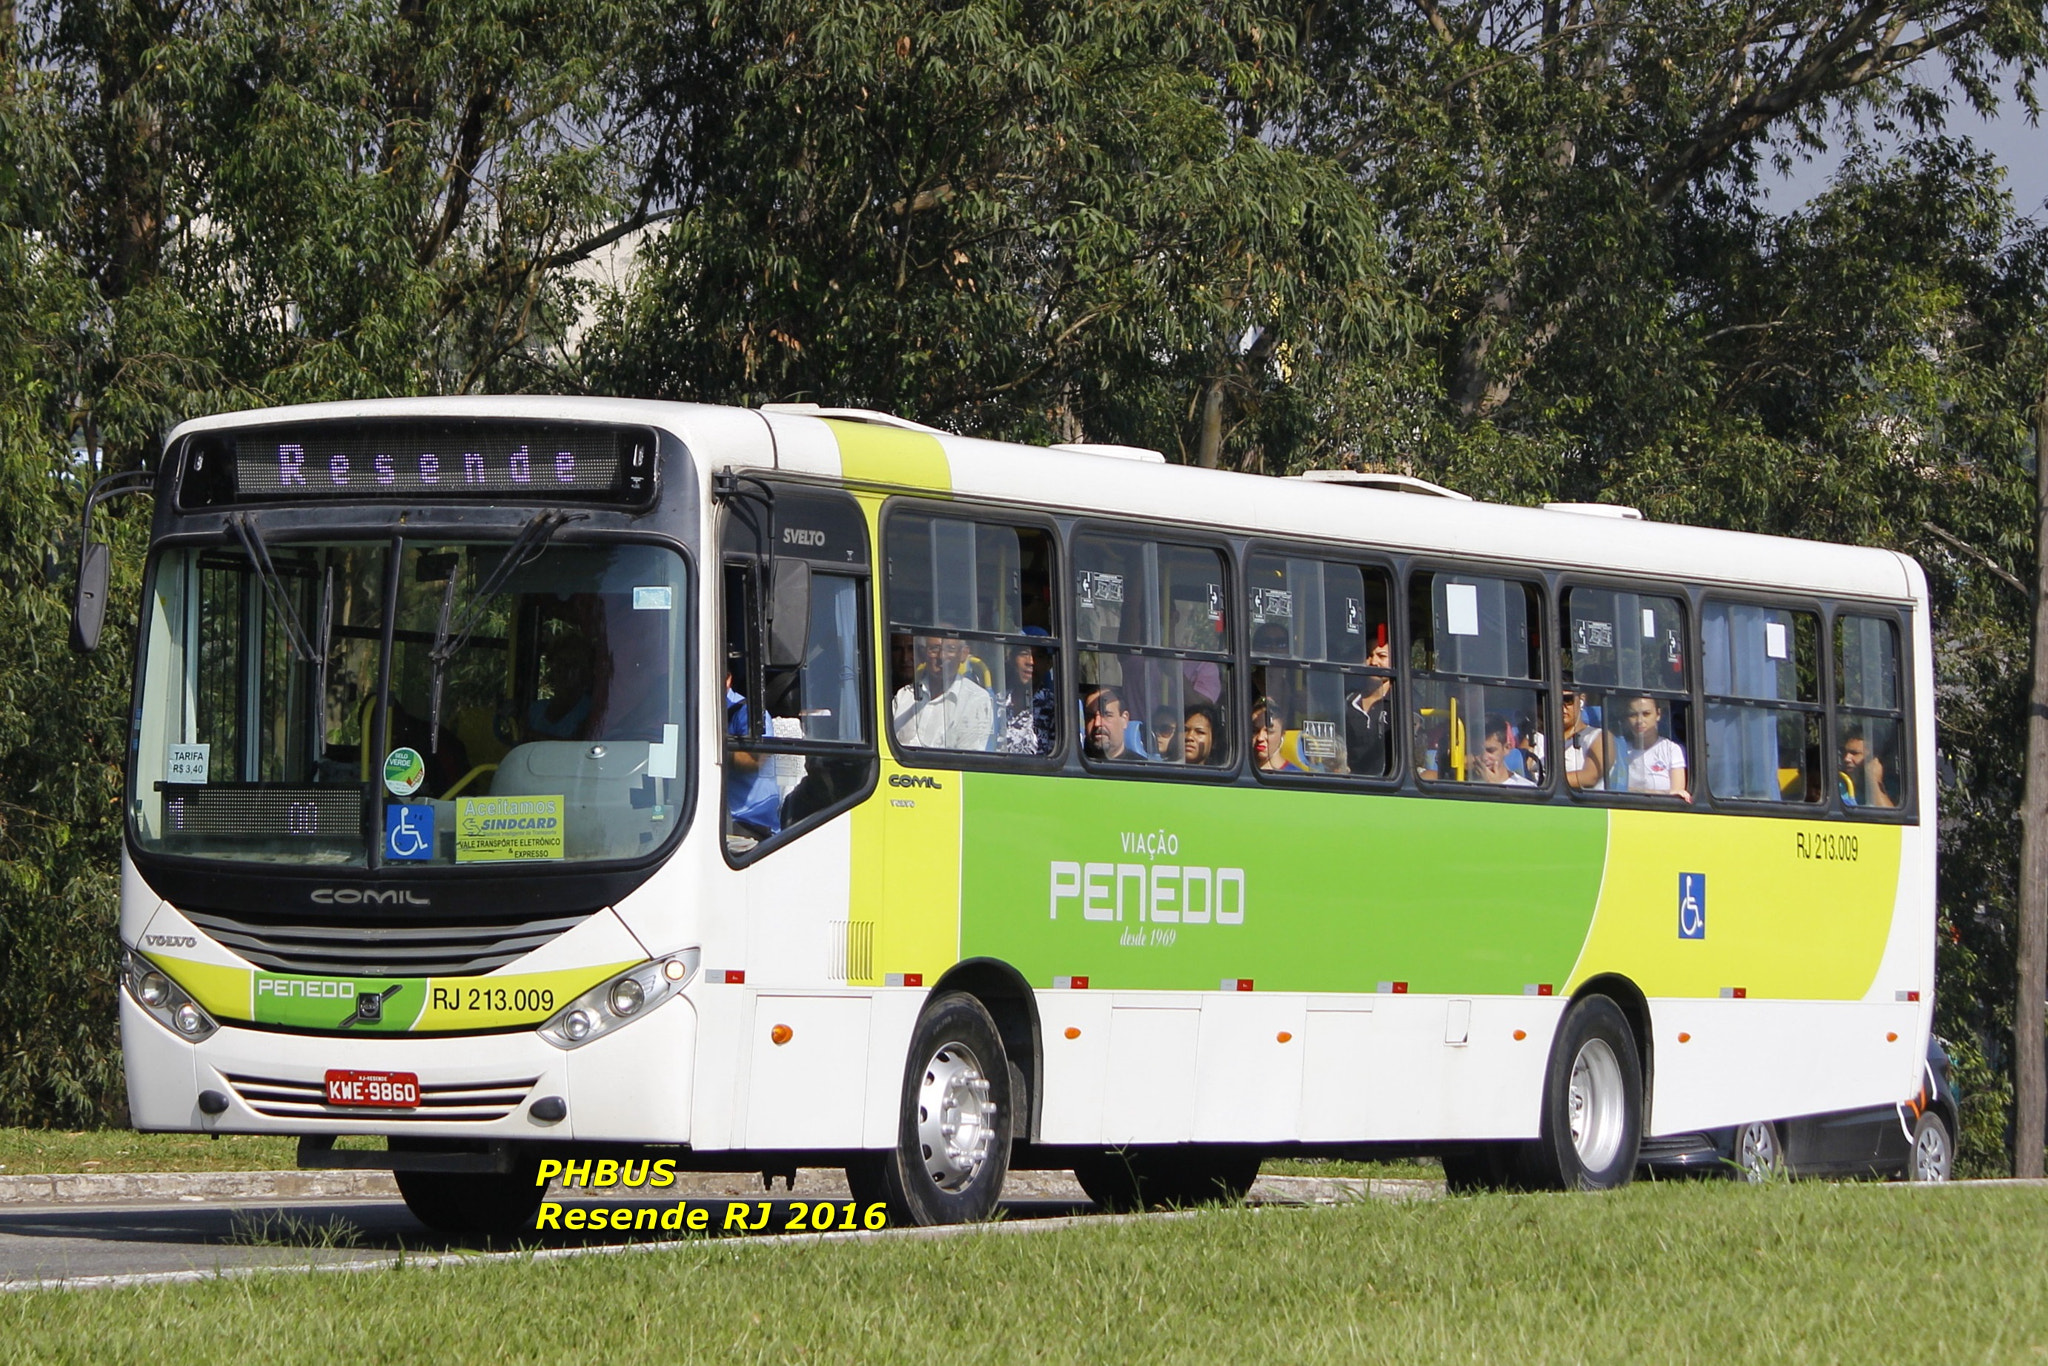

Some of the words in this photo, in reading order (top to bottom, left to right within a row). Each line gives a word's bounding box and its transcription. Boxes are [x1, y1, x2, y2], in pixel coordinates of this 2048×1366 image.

[278, 444, 577, 485] Resende
[783, 528, 826, 546] SVELTO
[174, 751, 204, 761] TARIFA
[390, 758, 411, 767] VERDE
[173, 764, 184, 774] R$
[186, 764, 203, 774] 3,40
[888, 774, 942, 789] COMIL
[464, 798, 556, 816] Aceitamos
[481, 817, 557, 830] SINDCARD
[459, 840, 475, 848] VALE
[1120, 829, 1179, 860] VIAÇÃO
[1796, 832, 1812, 859] RJ
[1815, 834, 1859, 861] 213.009
[515, 850, 549, 858] EXPRESSO
[310, 888, 431, 905] COMIL
[1050, 861, 1245, 924] PENEDO
[145, 935, 197, 948] VOLVO
[1119, 926, 1147, 946] desde
[1150, 928, 1177, 947] 1969
[258, 979, 354, 998] PENEDO
[433, 988, 460, 1010] RJ
[468, 989, 554, 1011] 213.009
[329, 1080, 416, 1102] KWE-9860
